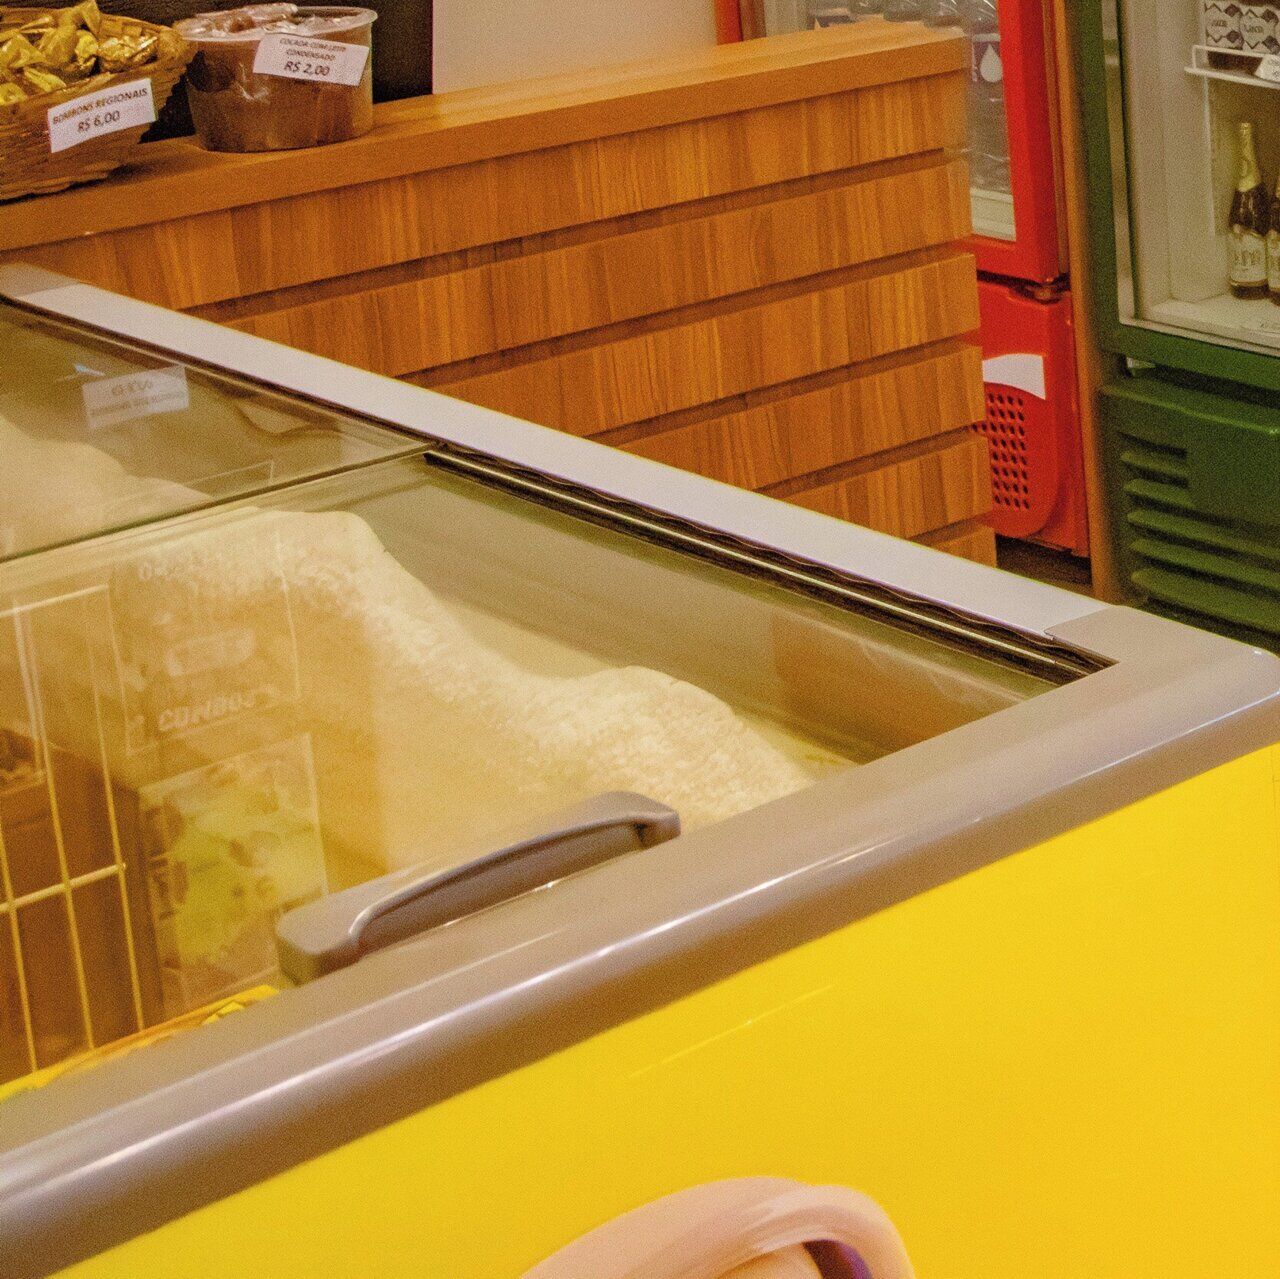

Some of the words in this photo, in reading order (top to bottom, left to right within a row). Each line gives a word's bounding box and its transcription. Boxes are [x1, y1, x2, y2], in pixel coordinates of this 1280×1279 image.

[285, 49, 337, 62] CONDENSADO
[284, 60, 301, 74] R$
[303, 62, 331, 77] 2,00
[52, 102, 94, 126] BOMBONS
[95, 87, 149, 113] REGIONAIS
[77, 117, 91, 134] R$
[93, 109, 121, 128] 6,00
